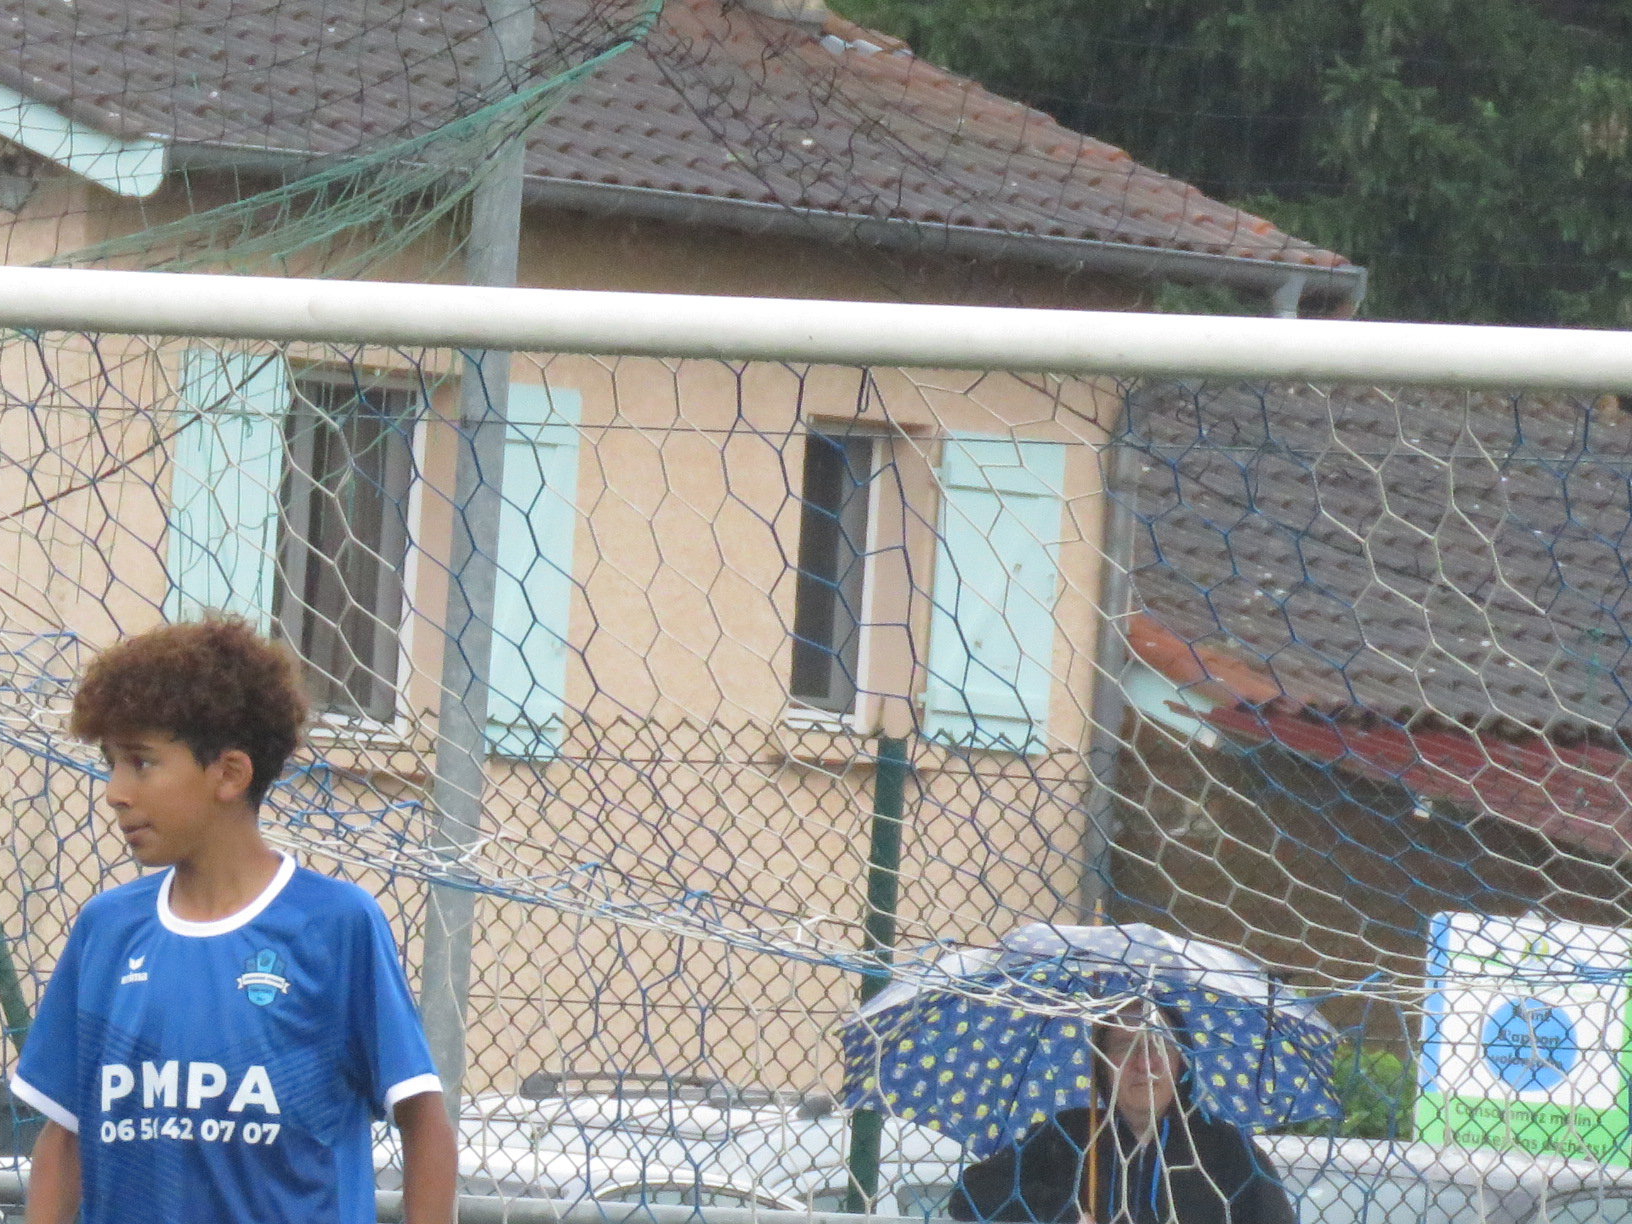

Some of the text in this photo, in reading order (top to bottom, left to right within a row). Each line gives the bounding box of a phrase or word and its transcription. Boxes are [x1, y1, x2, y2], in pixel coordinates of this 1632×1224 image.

[101, 1060, 281, 1115] PMPA
[101, 1118, 136, 1143] 06
[161, 1116, 194, 1141] 42
[201, 1118, 236, 1142] 07
[243, 1122, 281, 1146] 07
